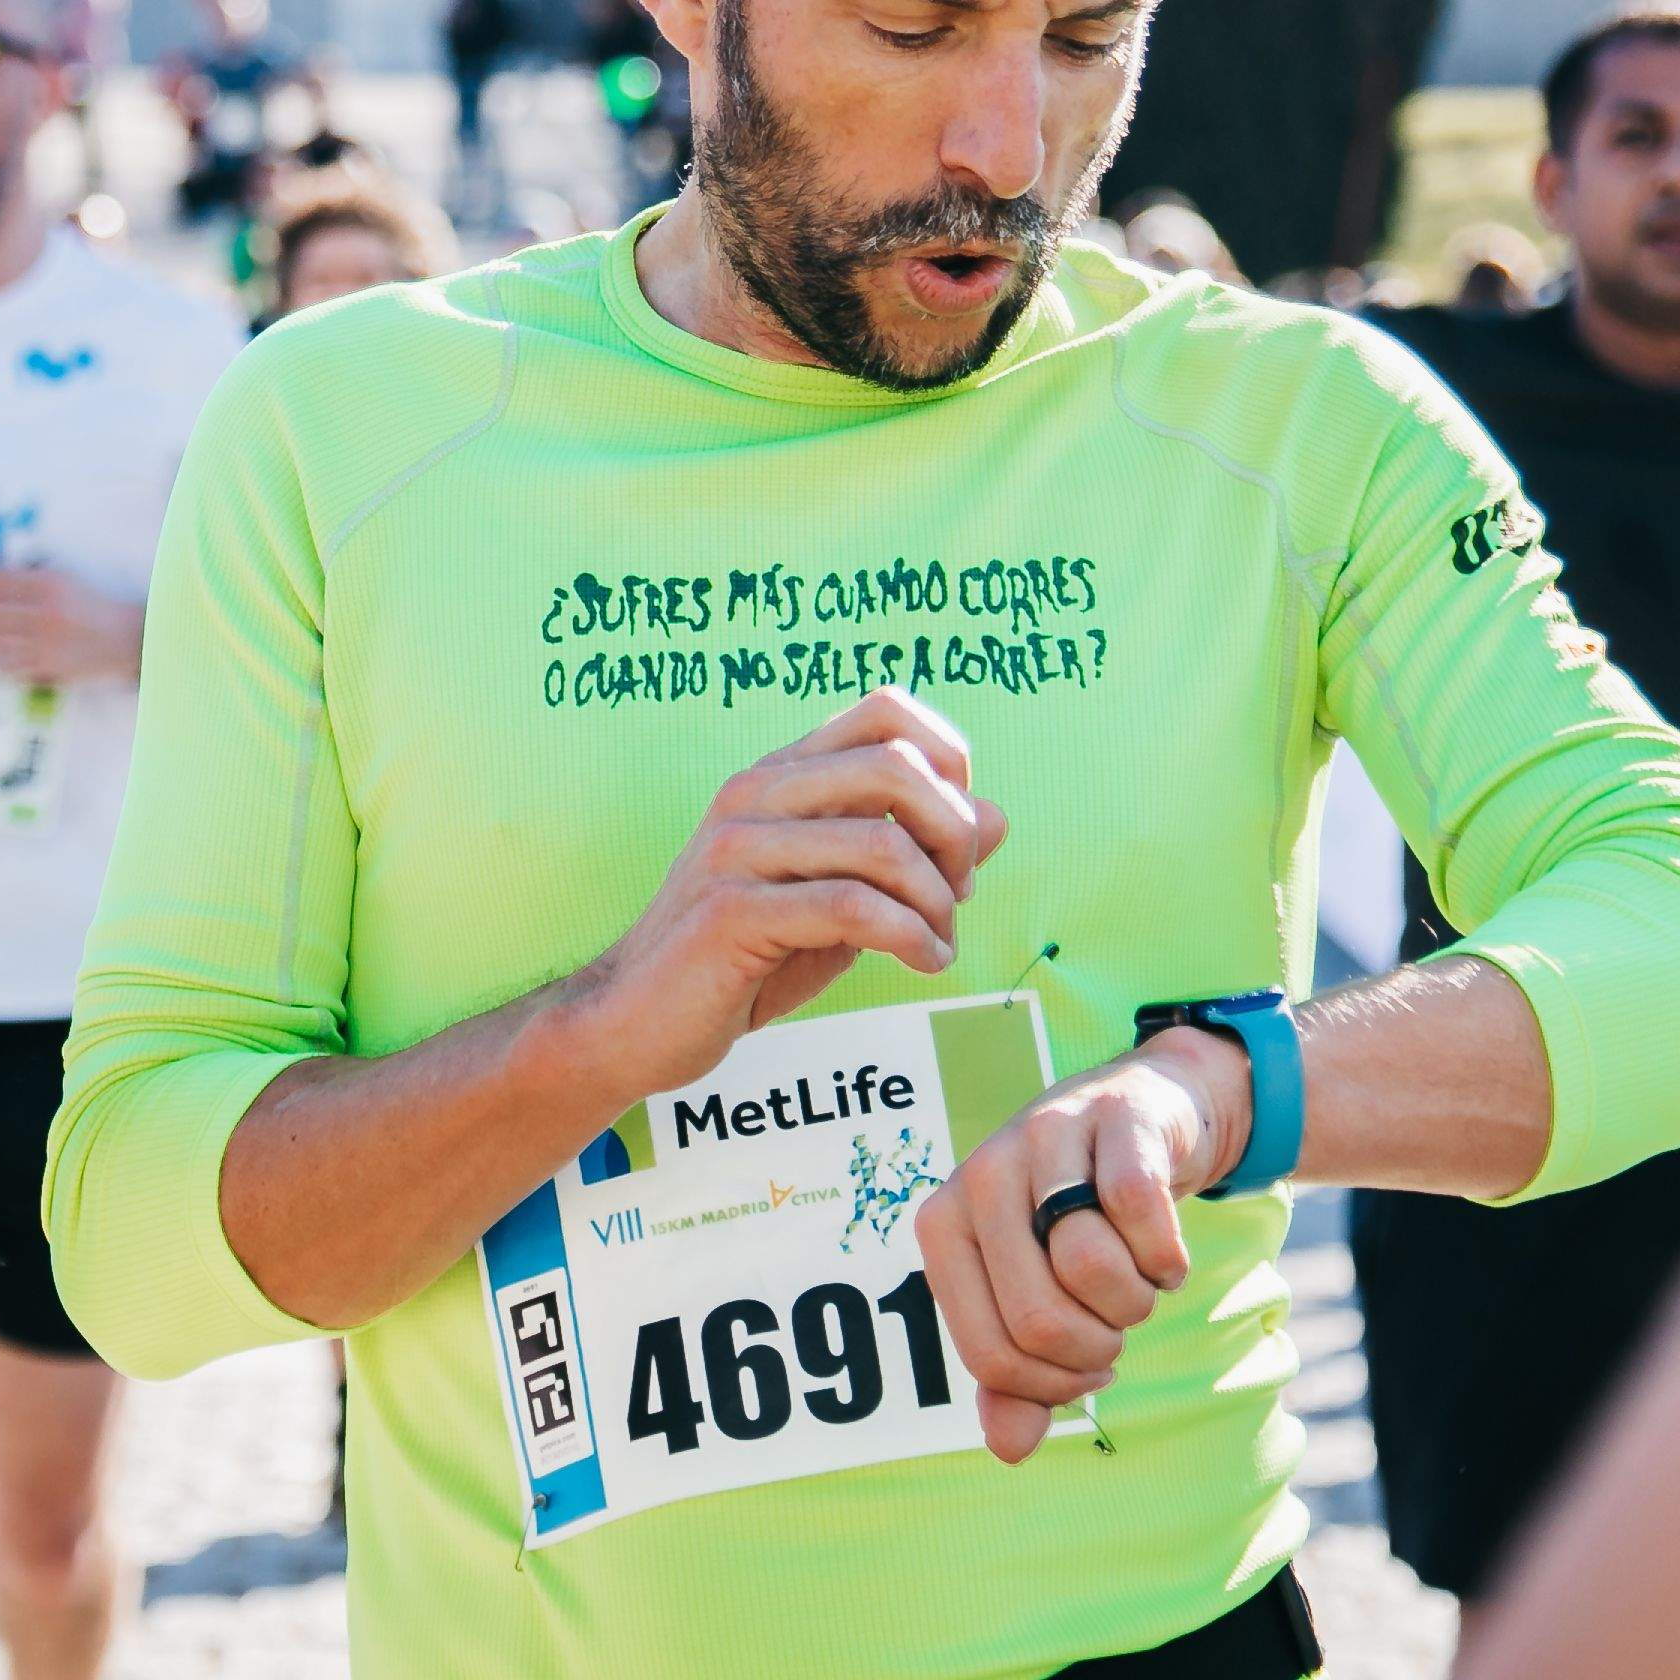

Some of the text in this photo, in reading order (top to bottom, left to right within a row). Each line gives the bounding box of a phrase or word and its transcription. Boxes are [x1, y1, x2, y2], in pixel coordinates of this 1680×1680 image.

[542, 556, 1096, 643] ¿SUFRES MÁS CUANDO CORRES
[544, 629, 1107, 709] O CUANDO NO SALES A CORRER?
[674, 1065, 915, 1149] MetLife
[590, 1206, 645, 1248] VIII
[650, 1215, 696, 1237] 15KM
[700, 1199, 770, 1226] MADRID
[627, 1270, 952, 1456] 4691
